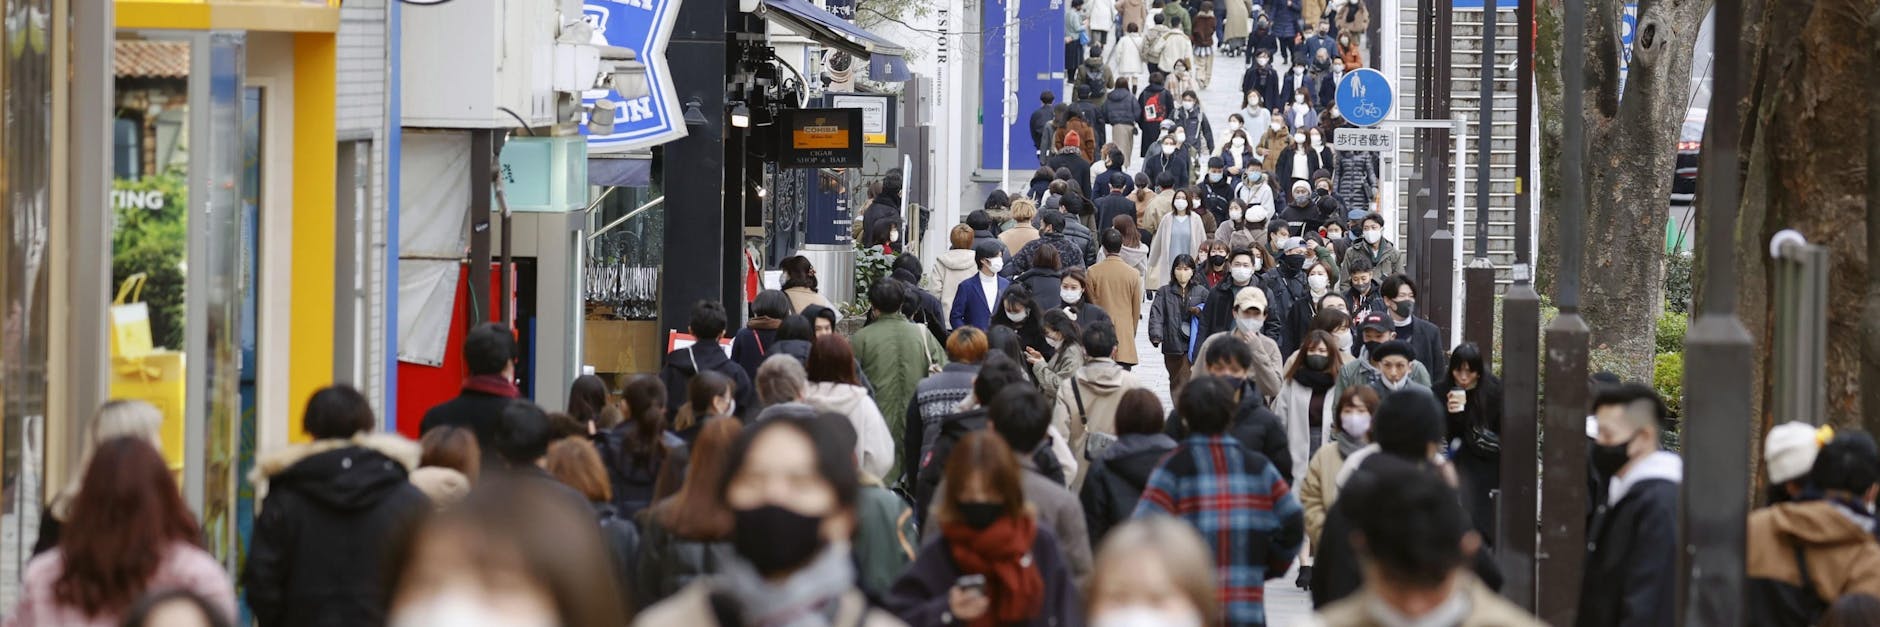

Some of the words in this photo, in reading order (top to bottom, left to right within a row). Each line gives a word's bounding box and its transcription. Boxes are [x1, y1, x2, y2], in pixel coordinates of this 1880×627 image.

[937, 10, 947, 64] ESPOIR
[1337, 133, 1390, 147] 歩行者優先
